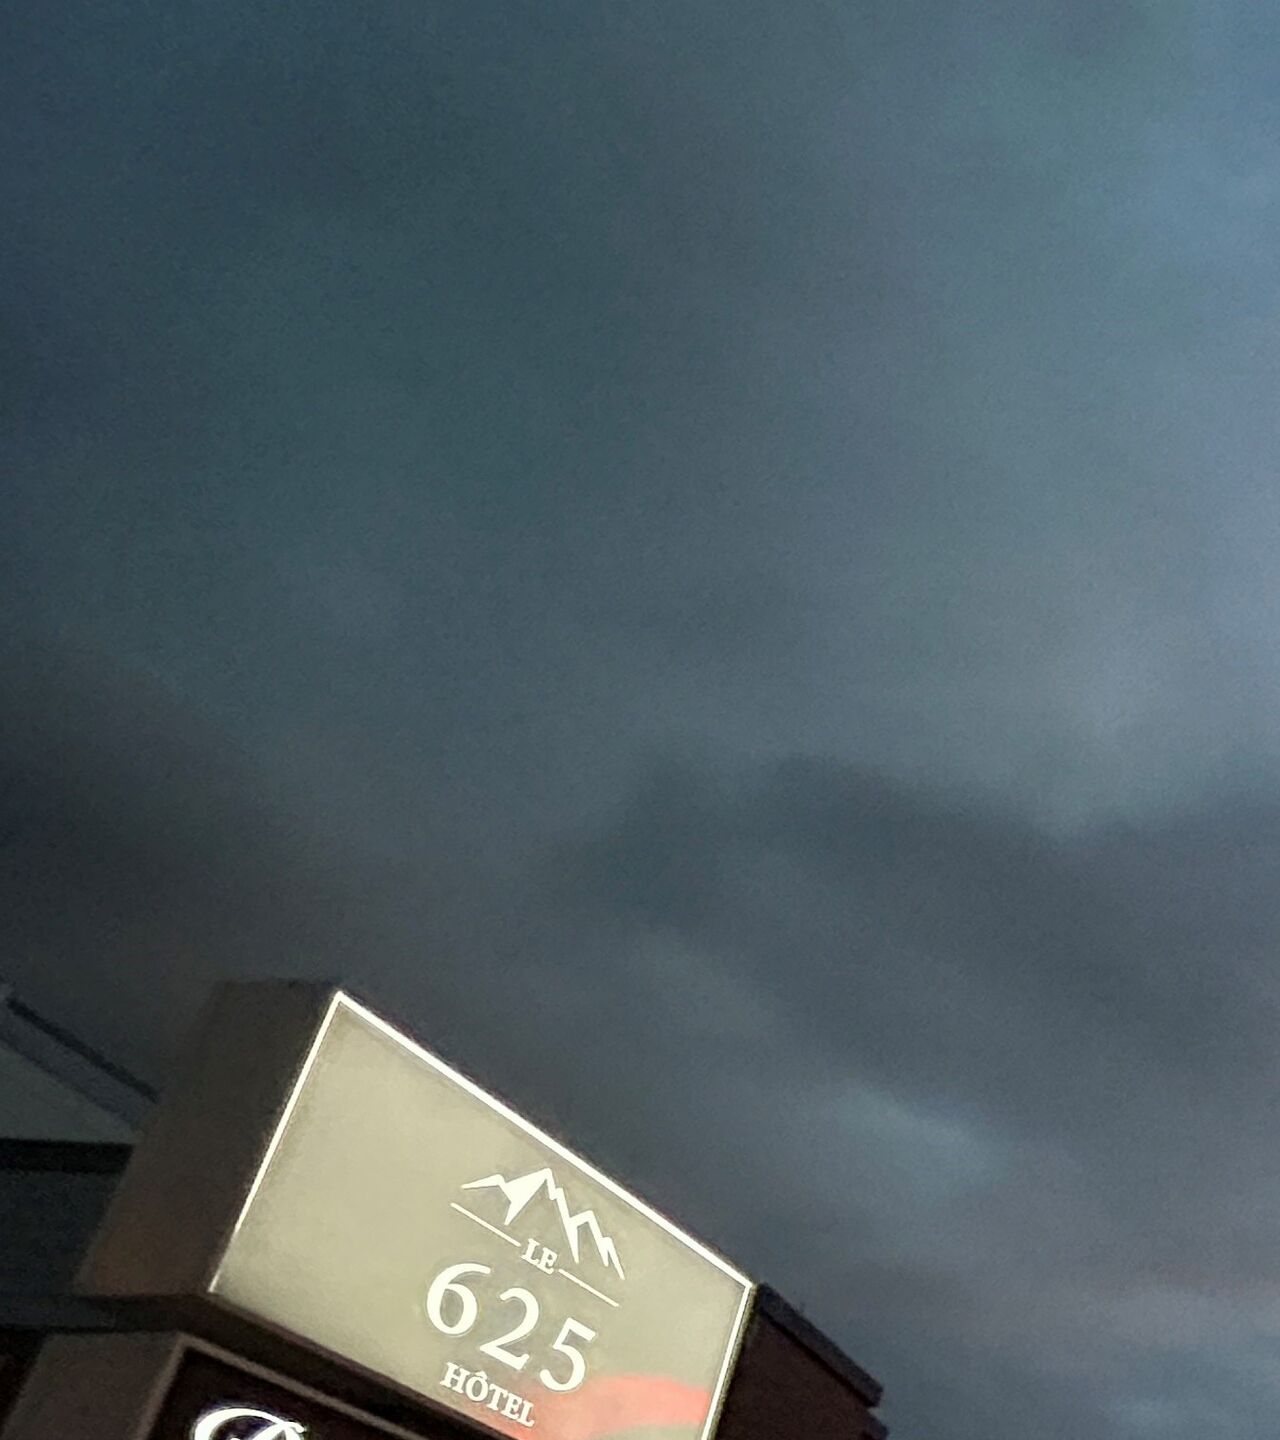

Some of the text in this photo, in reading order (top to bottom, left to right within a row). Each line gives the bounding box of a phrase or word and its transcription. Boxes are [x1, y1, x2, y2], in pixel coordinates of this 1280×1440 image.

[521, 1238, 558, 1275] LE
[426, 1262, 597, 1392] 625
[440, 1361, 536, 1428] HÔTEL
